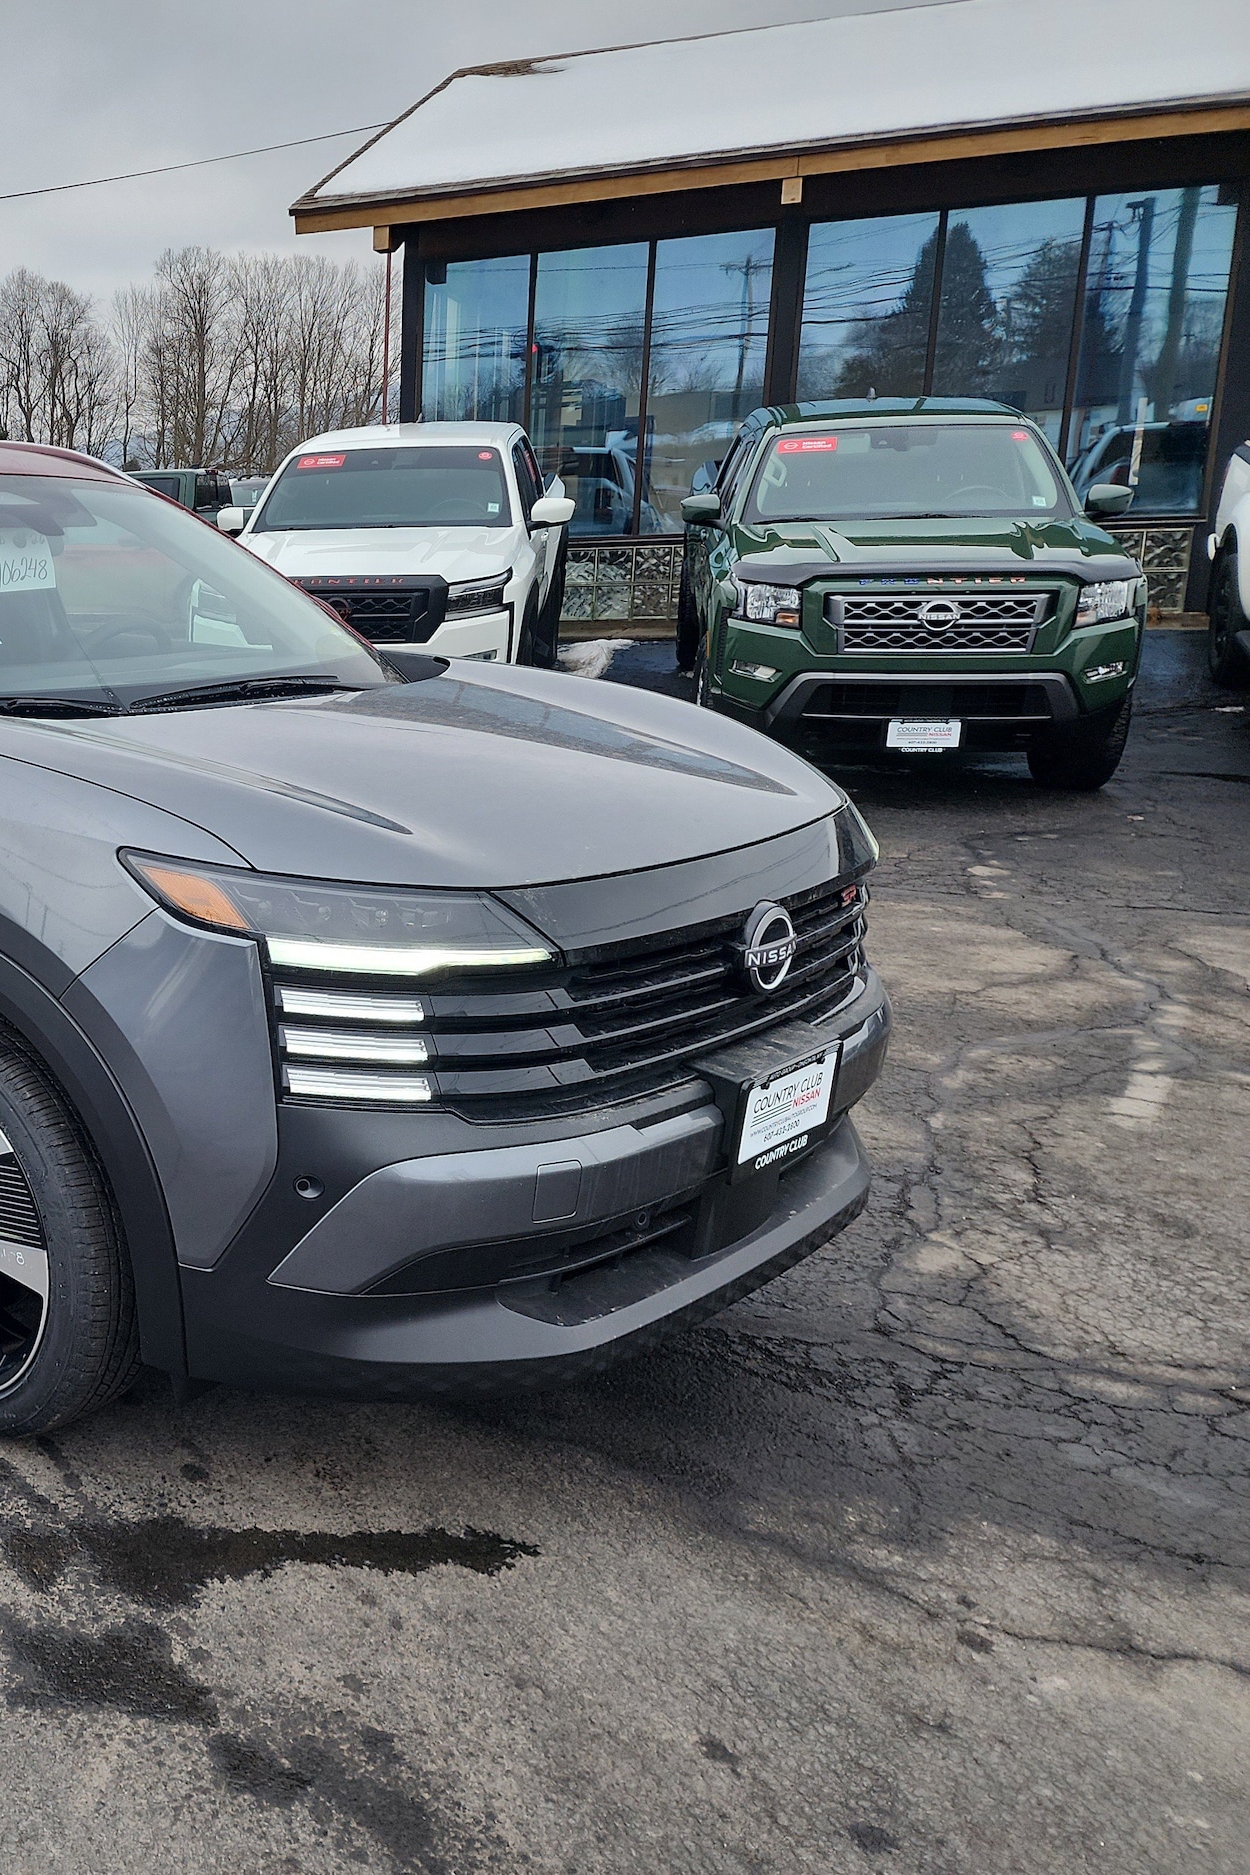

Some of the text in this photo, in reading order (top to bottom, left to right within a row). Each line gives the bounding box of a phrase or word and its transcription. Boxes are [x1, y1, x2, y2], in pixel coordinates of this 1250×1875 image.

[748, 943, 796, 966] NISSA
[753, 1071, 824, 1114] COUNTRY CLUB
[792, 1088, 822, 1108] NISSAN
[755, 1134, 809, 1170] COUNTRY CLUB
